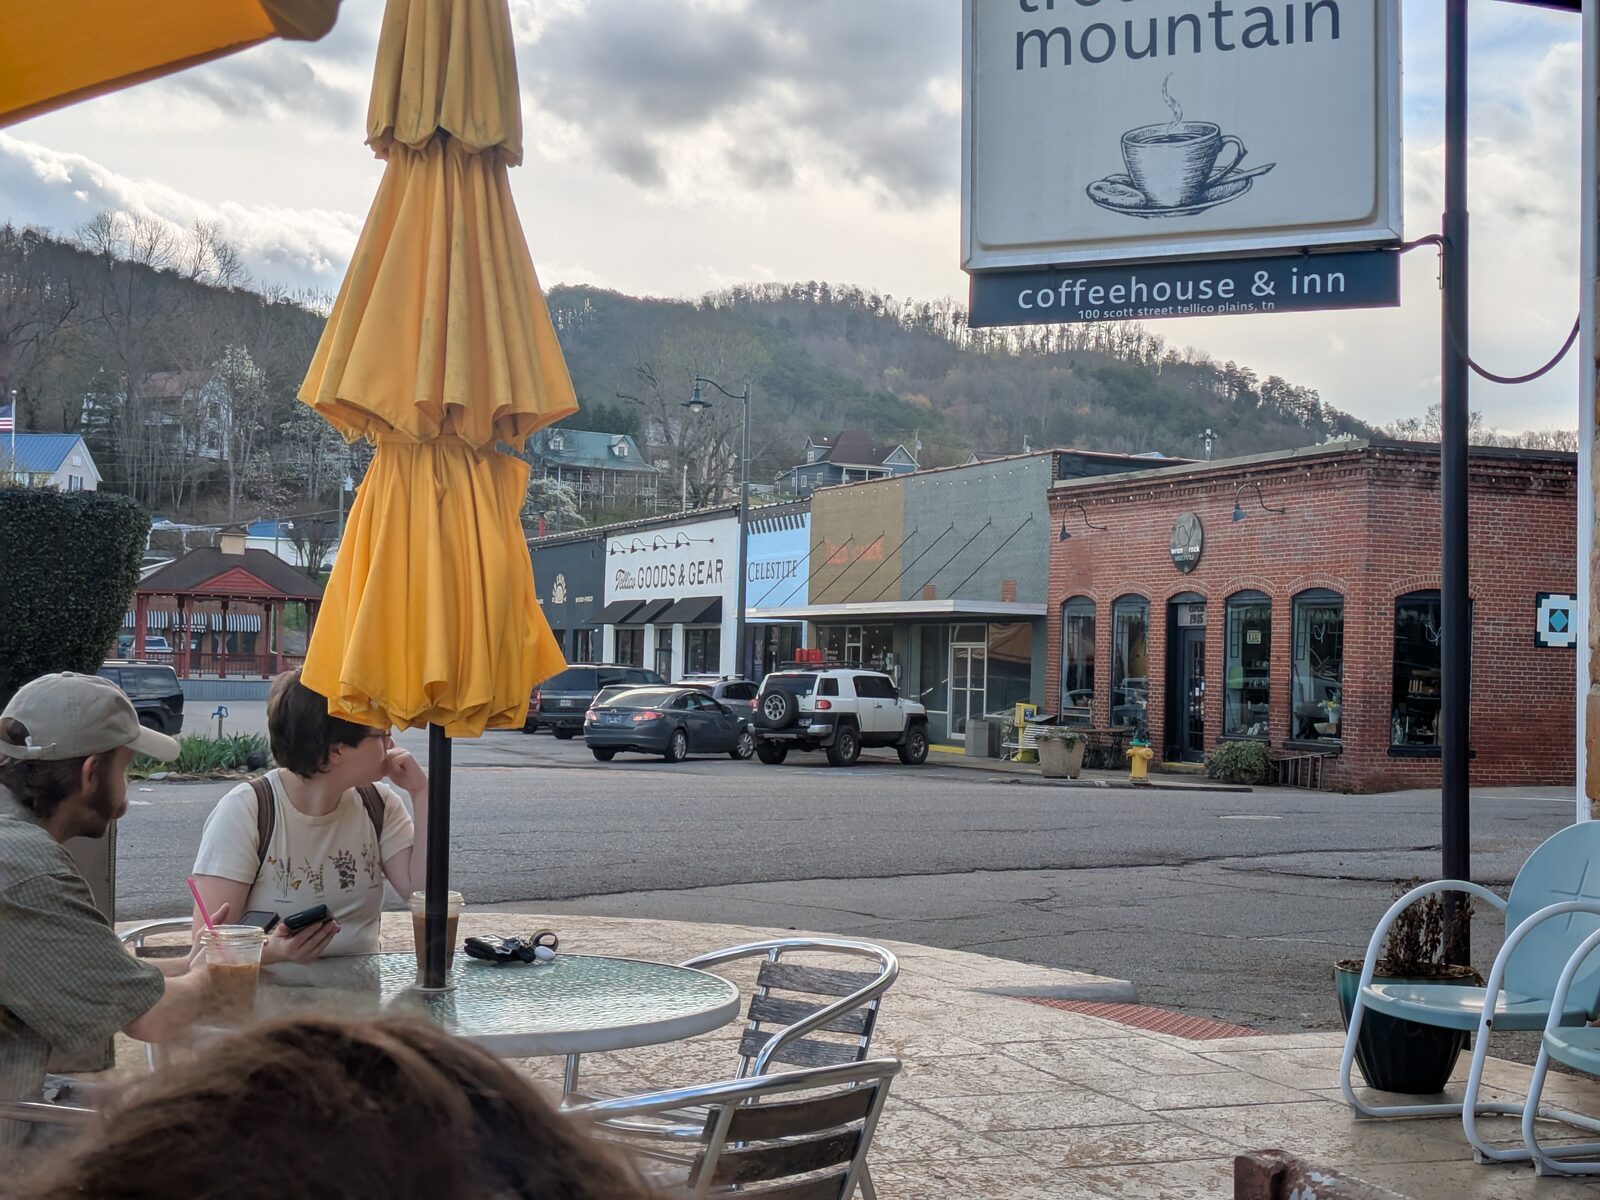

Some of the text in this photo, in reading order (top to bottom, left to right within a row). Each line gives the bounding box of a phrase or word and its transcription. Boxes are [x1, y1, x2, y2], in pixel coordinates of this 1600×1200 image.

[1016, 0, 1340, 70] mountain
[1018, 267, 1345, 309] coffeehouse & inn
[1078, 301, 1275, 320] 100 scott street tellico plains, tn
[615, 558, 723, 591] Tellico GOODS & GEAR
[747, 559, 798, 583] CELESTITE
